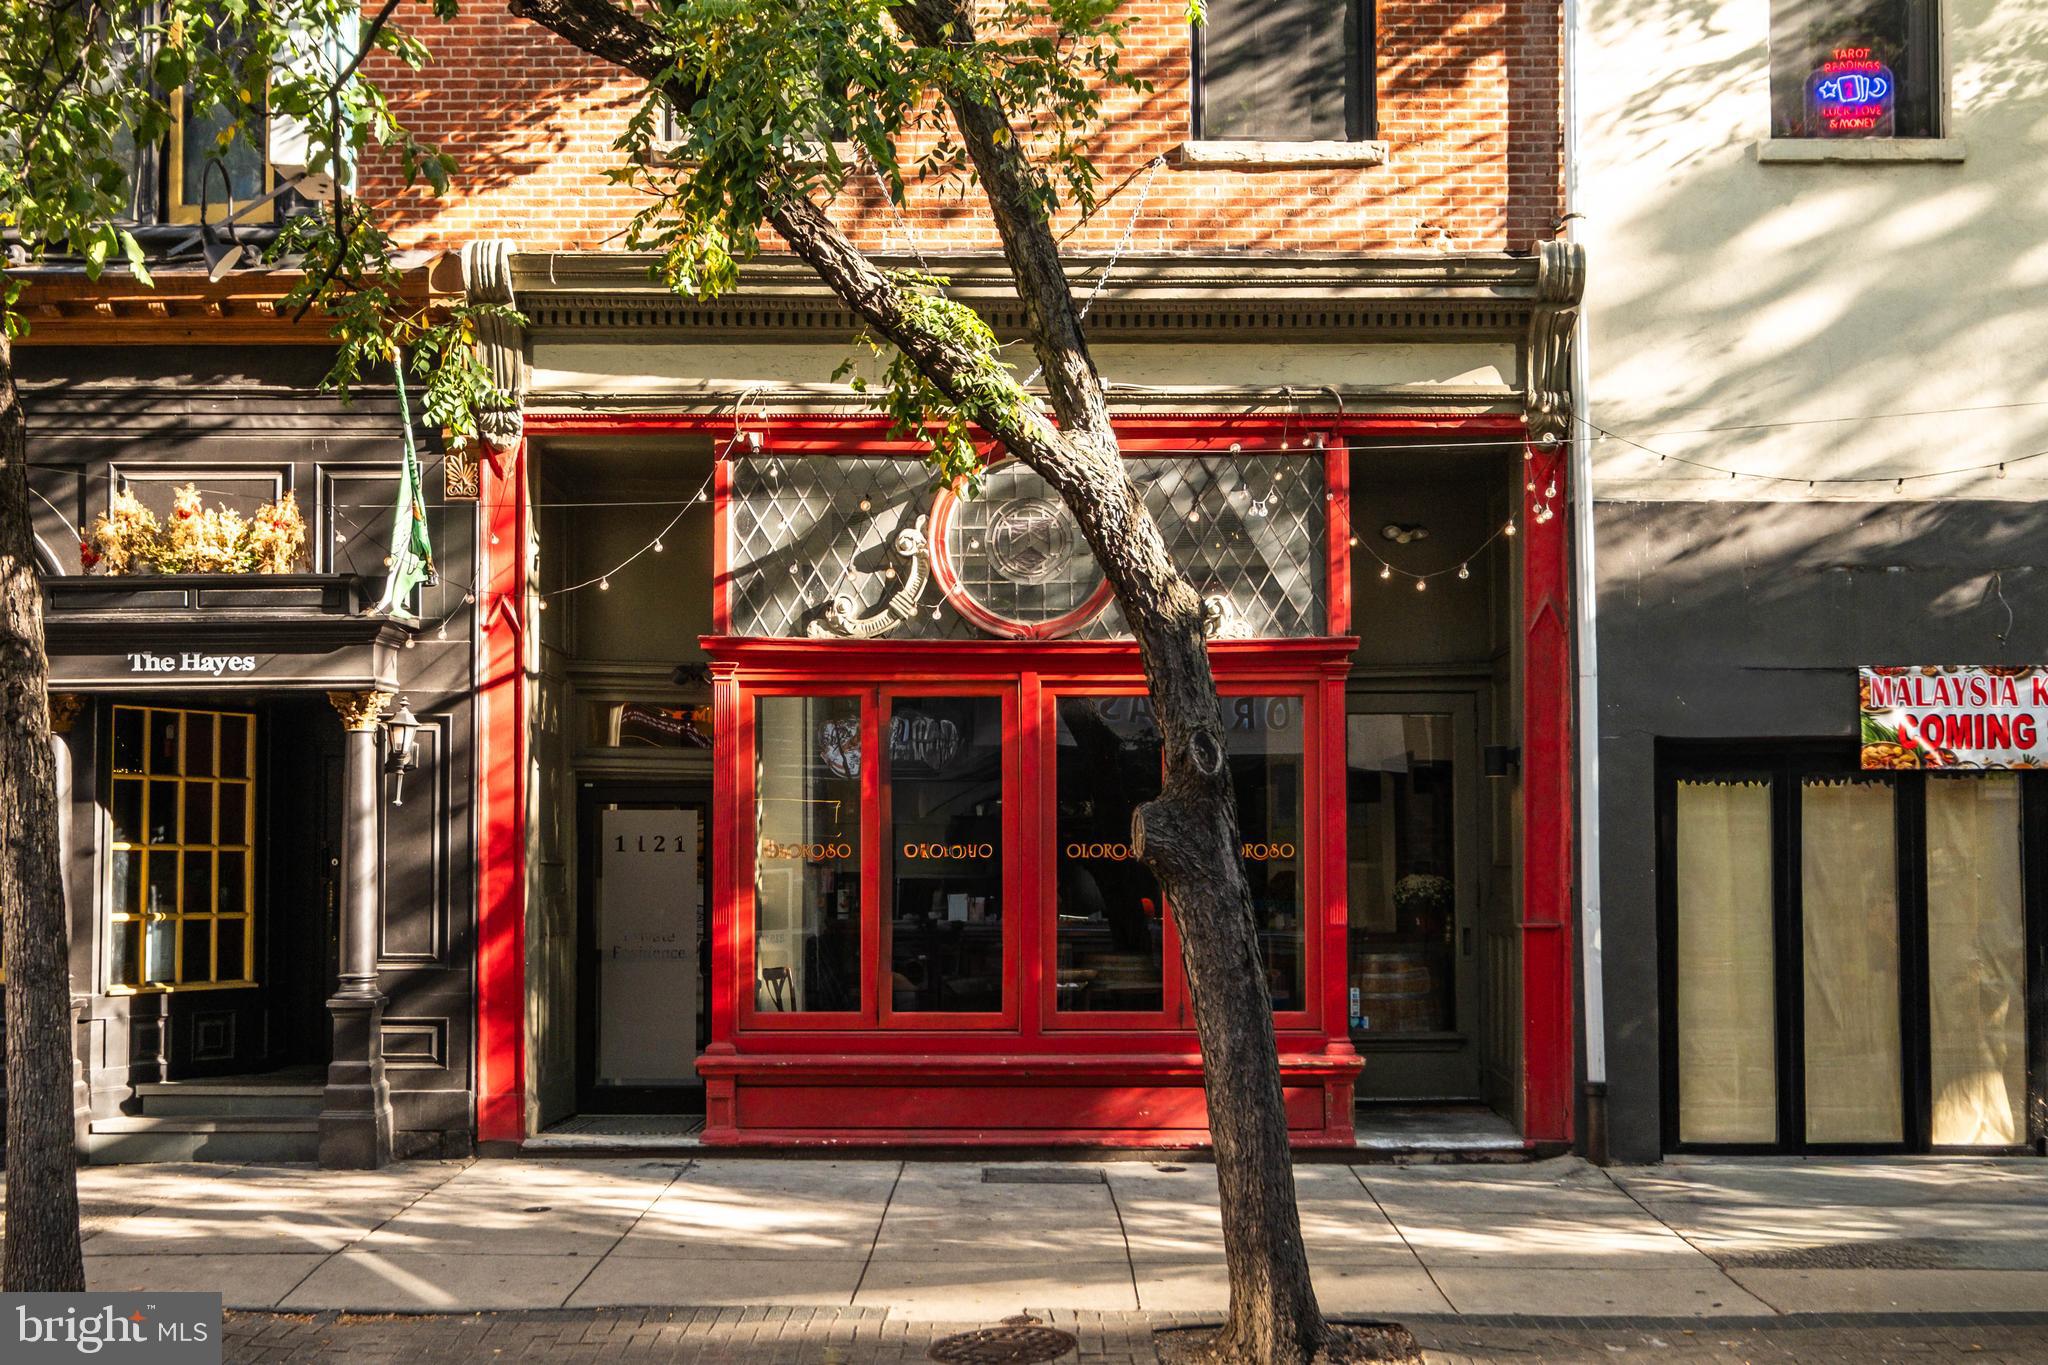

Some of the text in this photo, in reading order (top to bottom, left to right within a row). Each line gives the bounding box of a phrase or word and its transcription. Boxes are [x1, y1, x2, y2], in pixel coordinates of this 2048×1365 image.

[1833, 48, 1870, 59] TAROT
[1824, 61, 1881, 72] READINGS
[1840, 118, 1875, 128] MONEY
[127, 651, 256, 676] The Hayes
[1871, 676, 2018, 707] MALAYSIA
[1898, 713, 2037, 750] COMING
[1066, 843, 1135, 861] OLORO
